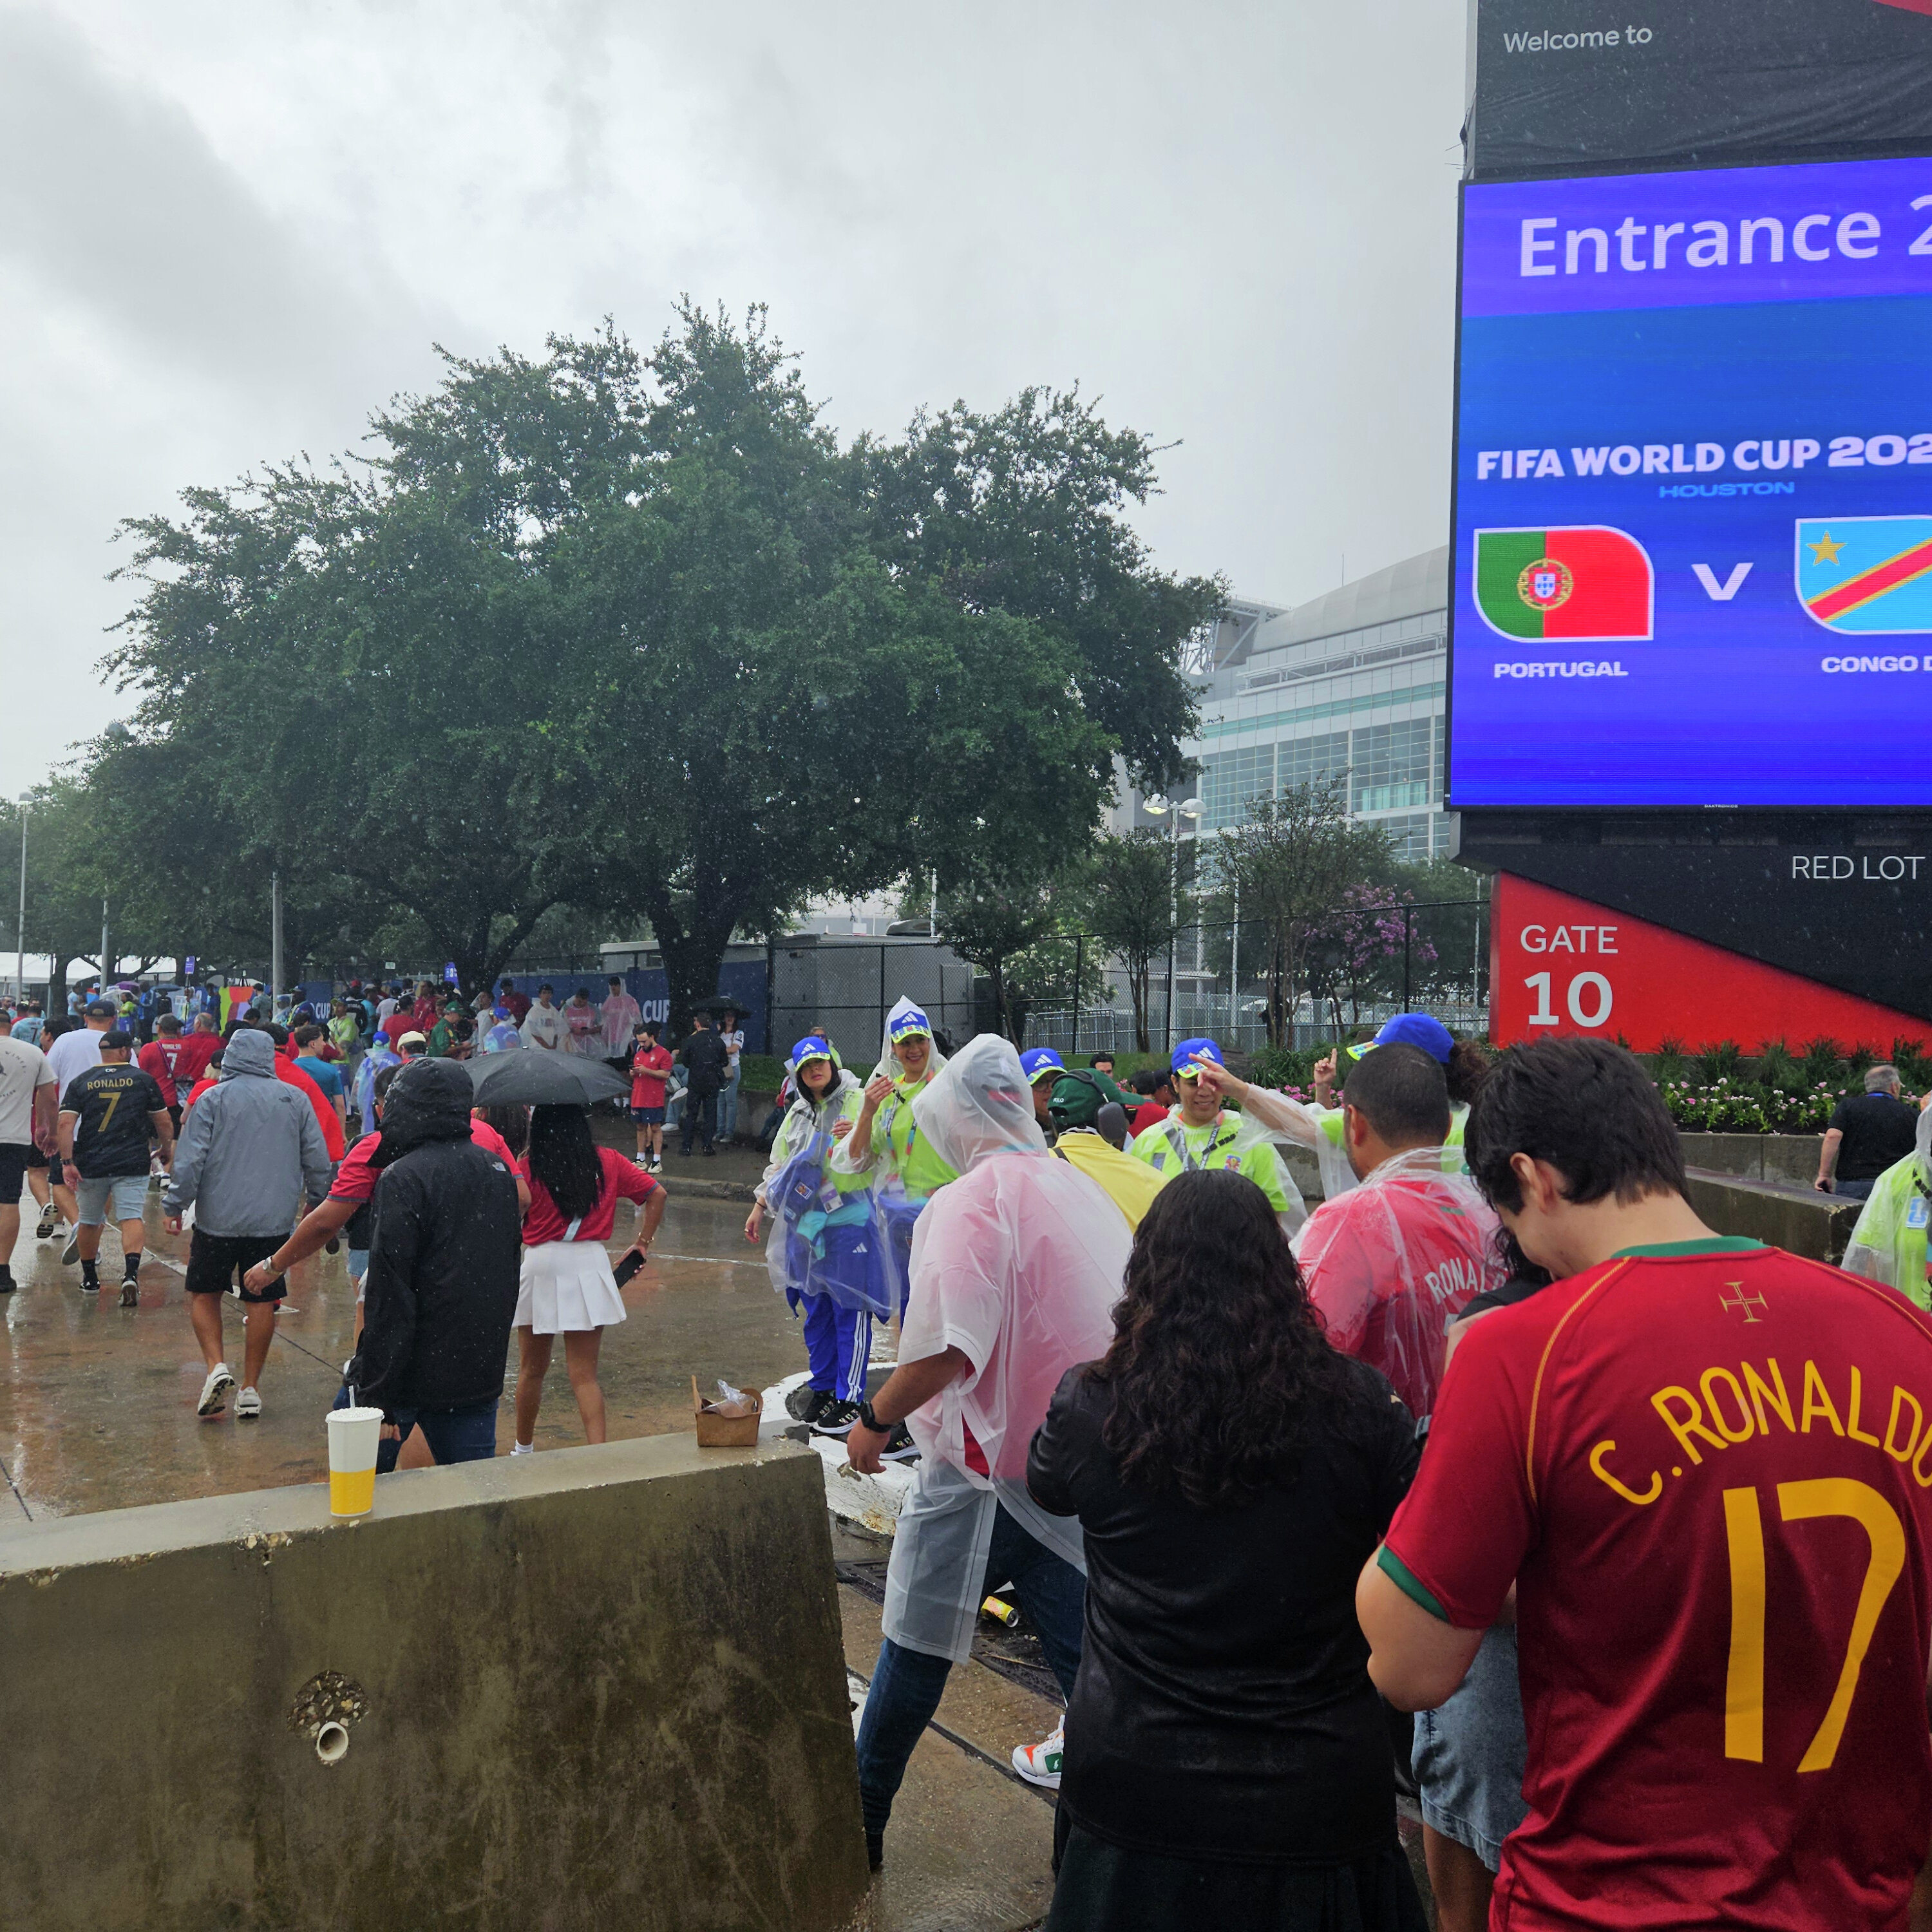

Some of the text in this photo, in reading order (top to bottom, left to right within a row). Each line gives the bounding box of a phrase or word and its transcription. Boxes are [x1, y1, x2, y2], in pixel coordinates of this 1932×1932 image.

[1503, 24, 1653, 53] Welcome to
[1520, 211, 1881, 278] Entrance
[1477, 448, 1566, 480] FIFA
[1572, 443, 1725, 475] WORLD
[1733, 439, 1821, 471] CUP
[1659, 482, 1795, 498] HOUSTON
[1691, 562, 1754, 601] V
[1493, 661, 1629, 678] PORTUGAL
[1821, 656, 1919, 673] CONGO
[1792, 855, 1926, 880] RED LOT
[1520, 925, 1618, 954] GATE
[316, 1002, 331, 1019] CUP
[1524, 971, 1613, 1027] 10
[166, 1052, 178, 1071] 7
[87, 1077, 133, 1090] RONALDO
[98, 1092, 122, 1132] 7
[1723, 1477, 1906, 1773] 17
